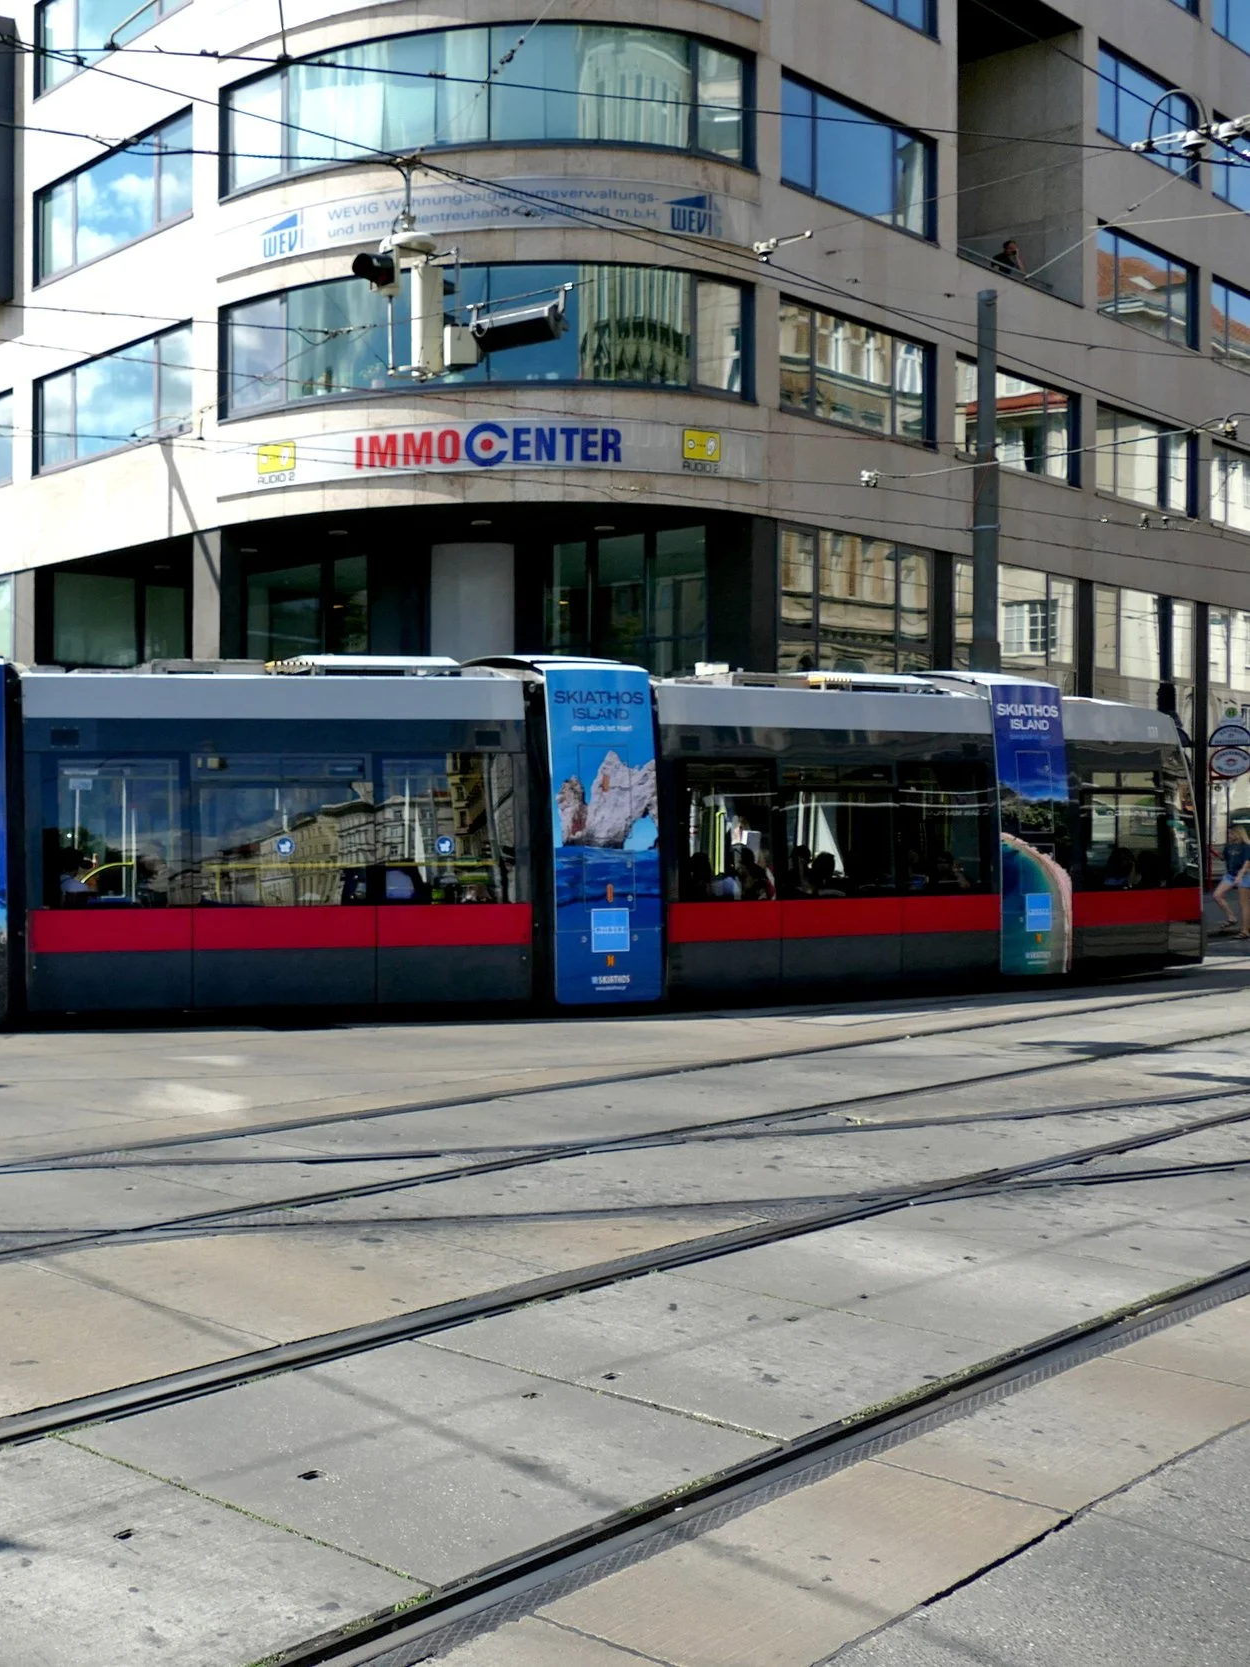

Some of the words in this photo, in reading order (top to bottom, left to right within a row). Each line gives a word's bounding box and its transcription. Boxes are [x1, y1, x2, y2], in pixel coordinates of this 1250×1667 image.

[328, 202, 378, 221] WEVIG
[328, 223, 354, 239] und
[682, 461, 711, 473] AUDIO
[713, 463, 719, 474] 2
[257, 473, 287, 485] AUDIO
[288, 471, 295, 481] 2
[554, 690, 645, 705] SKIATHOS
[572, 707, 630, 720] ISLAND
[996, 703, 1059, 718] SKIATHOS
[1010, 718, 1050, 731] ISLAND
